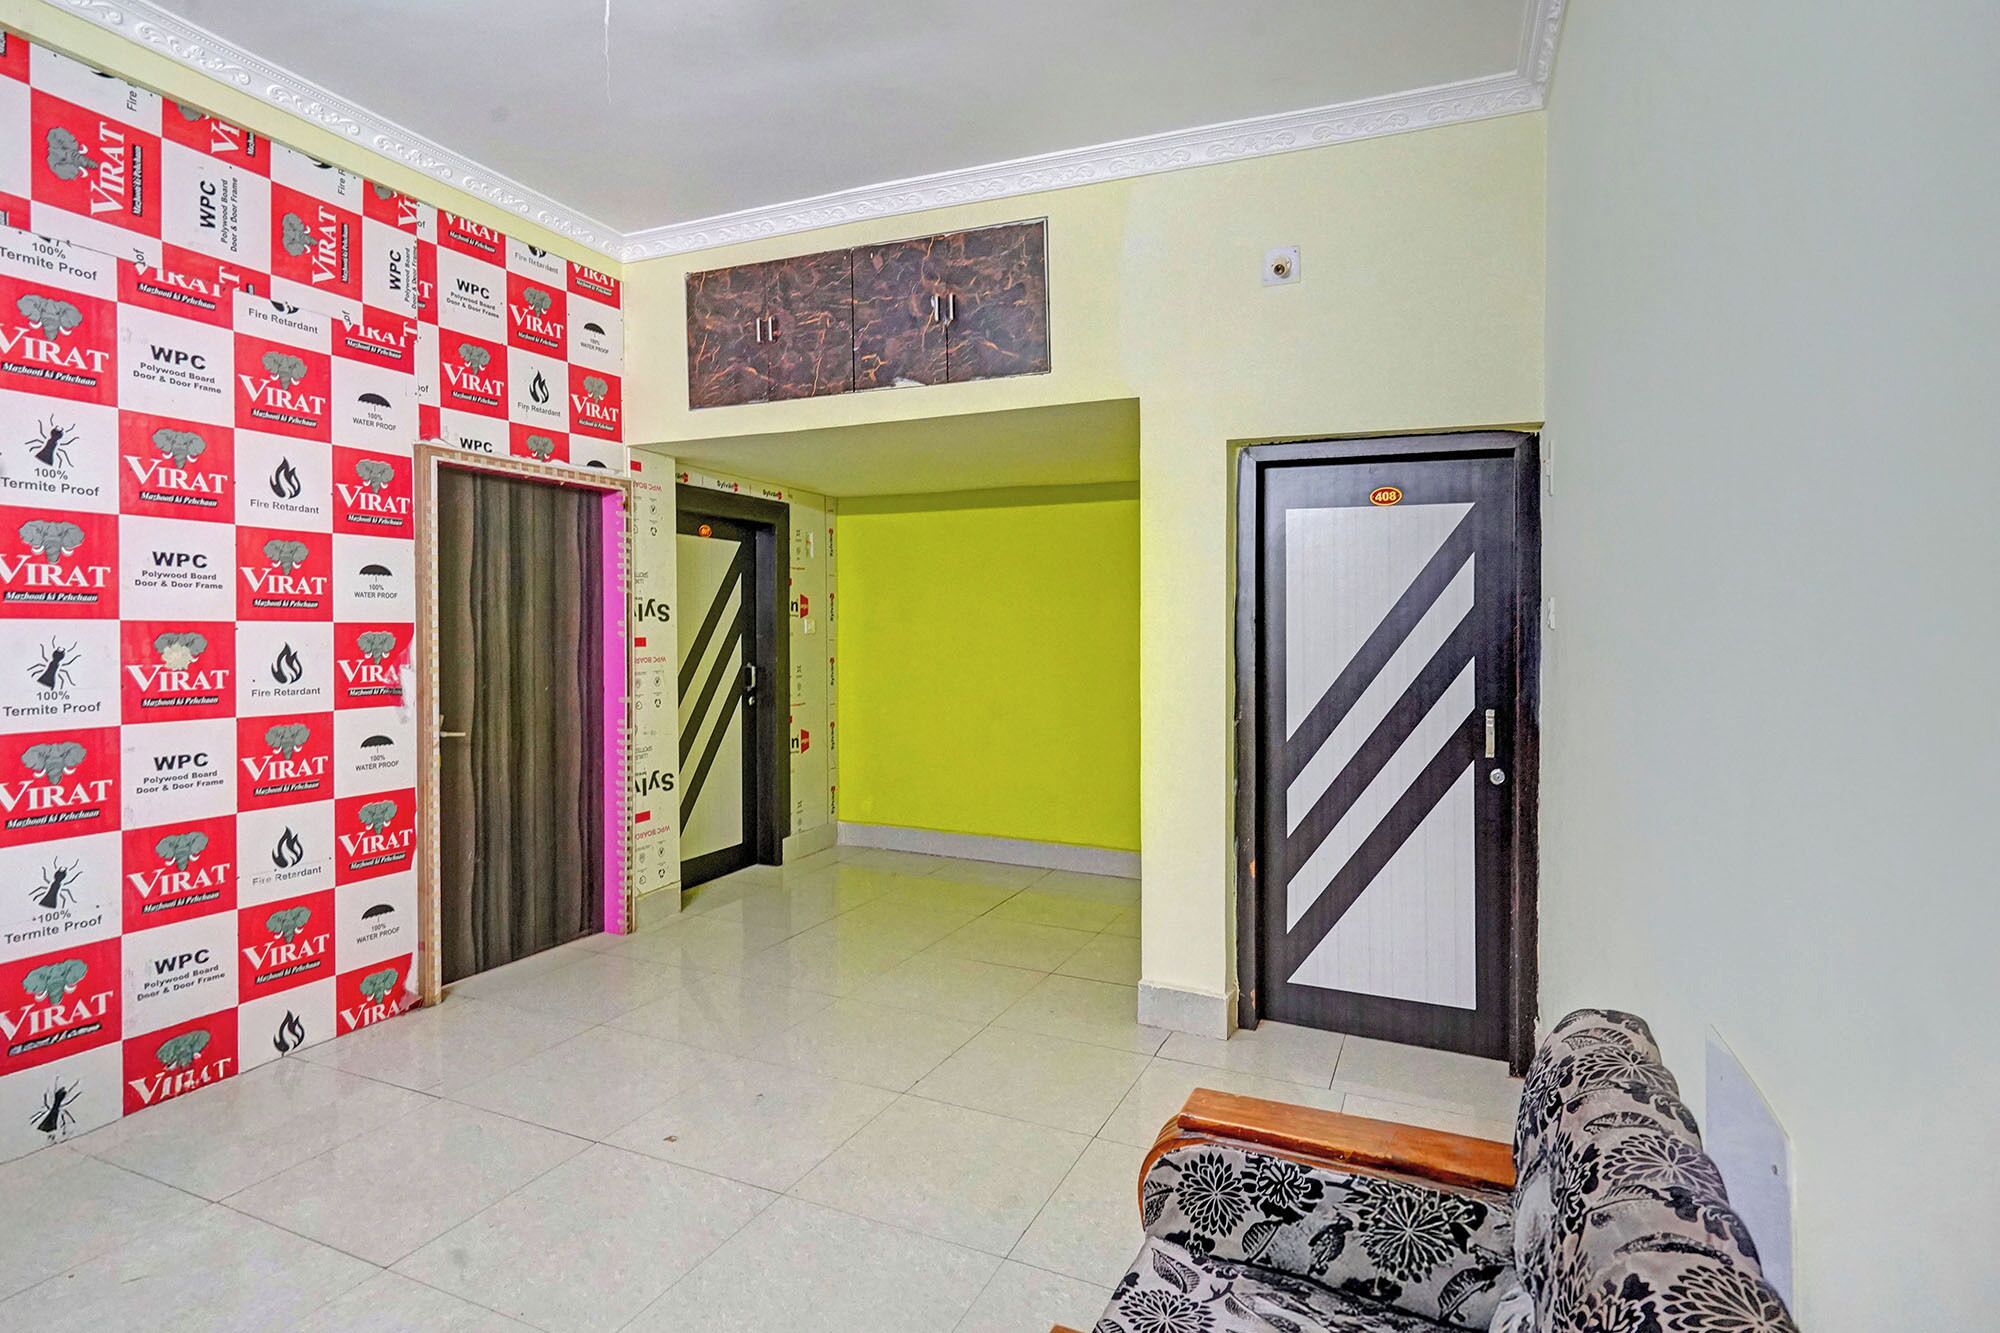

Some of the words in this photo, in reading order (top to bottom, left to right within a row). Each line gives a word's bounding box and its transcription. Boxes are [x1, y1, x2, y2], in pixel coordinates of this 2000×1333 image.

[91, 122, 124, 215] VIRAT
[200, 181, 216, 229] WPC
[32, 242, 66, 260] 100%
[312, 206, 336, 284] VIRAT
[0, 247, 54, 269] Termite
[58, 259, 98, 281] Proof
[389, 250, 401, 291] WPC
[456, 278, 490, 300] WPC
[248, 308, 268, 321] Fire
[272, 314, 318, 334] Retardant
[509, 303, 564, 339] VIRAT
[0, 323, 109, 373] VIRAT
[150, 344, 206, 370] WPC
[133, 370, 155, 382] Door
[170, 378, 190, 389] Door
[194, 382, 222, 394] Frame
[140, 362, 186, 378] Polywood
[188, 372, 216, 384] Board
[442, 362, 504, 396] VIRAT
[238, 374, 325, 416] VIRAT
[571, 394, 619, 422] VIRAT
[352, 418, 374, 428] WATER
[376, 422, 396, 431] PROOF
[460, 437, 493, 453] WPC
[1, 477, 56, 493] Termite
[62, 485, 100, 496] Proof
[34, 468, 68, 480] 100%
[124, 455, 228, 494] VIRAT
[250, 499, 270, 509] Fire
[272, 502, 320, 514] Retardant
[336, 483, 411, 514] VIRAT
[1374, 491, 1396, 502] 408
[0, 554, 110, 588] VIRAT
[152, 551, 208, 569] WPC
[135, 580, 157, 588] Door
[160, 580, 168, 588] &
[172, 580, 193, 588] Door
[196, 582, 223, 590] Frame
[142, 570, 188, 580] Polywood
[190, 572, 216, 580] Board
[240, 566, 327, 596] VIRAT
[128, 664, 229, 692] VIRAT
[337, 658, 402, 684] VIRA
[36, 690, 70, 700] 100%
[251, 688, 270, 697] Fire
[274, 687, 320, 696] Retardant
[2, 704, 58, 716] Termite
[63, 702, 102, 714] Proof
[154, 752, 209, 771] WPC
[241, 755, 328, 782] VIRAT
[356, 764, 377, 772] WATER
[378, 760, 399, 769] PROOF
[136, 786, 158, 794] Door
[162, 784, 168, 792] &
[172, 782, 194, 790] Door
[197, 778, 224, 788] Frame
[144, 774, 188, 784] Polywood
[192, 770, 218, 779] Board
[0, 779, 112, 812] VIRAT
[338, 828, 412, 857] VIRAT
[128, 863, 230, 898] VIRAT
[252, 876, 272, 886] Fire
[274, 866, 322, 882] Retardant
[4, 926, 59, 944] Termite
[65, 914, 103, 931] Proof
[38, 910, 71, 924] 100%
[356, 932, 378, 944] WATER
[380, 926, 400, 938] PROOF
[154, 949, 210, 975] WPC
[242, 934, 330, 970] VIRAT
[137, 990, 160, 1002] Door
[174, 980, 195, 992] Door
[198, 972, 225, 985] Frame
[144, 973, 190, 990] Polywood
[193, 965, 219, 976] Board
[0, 990, 114, 1040] VIRAT
[340, 1000, 403, 1031] VIRA
